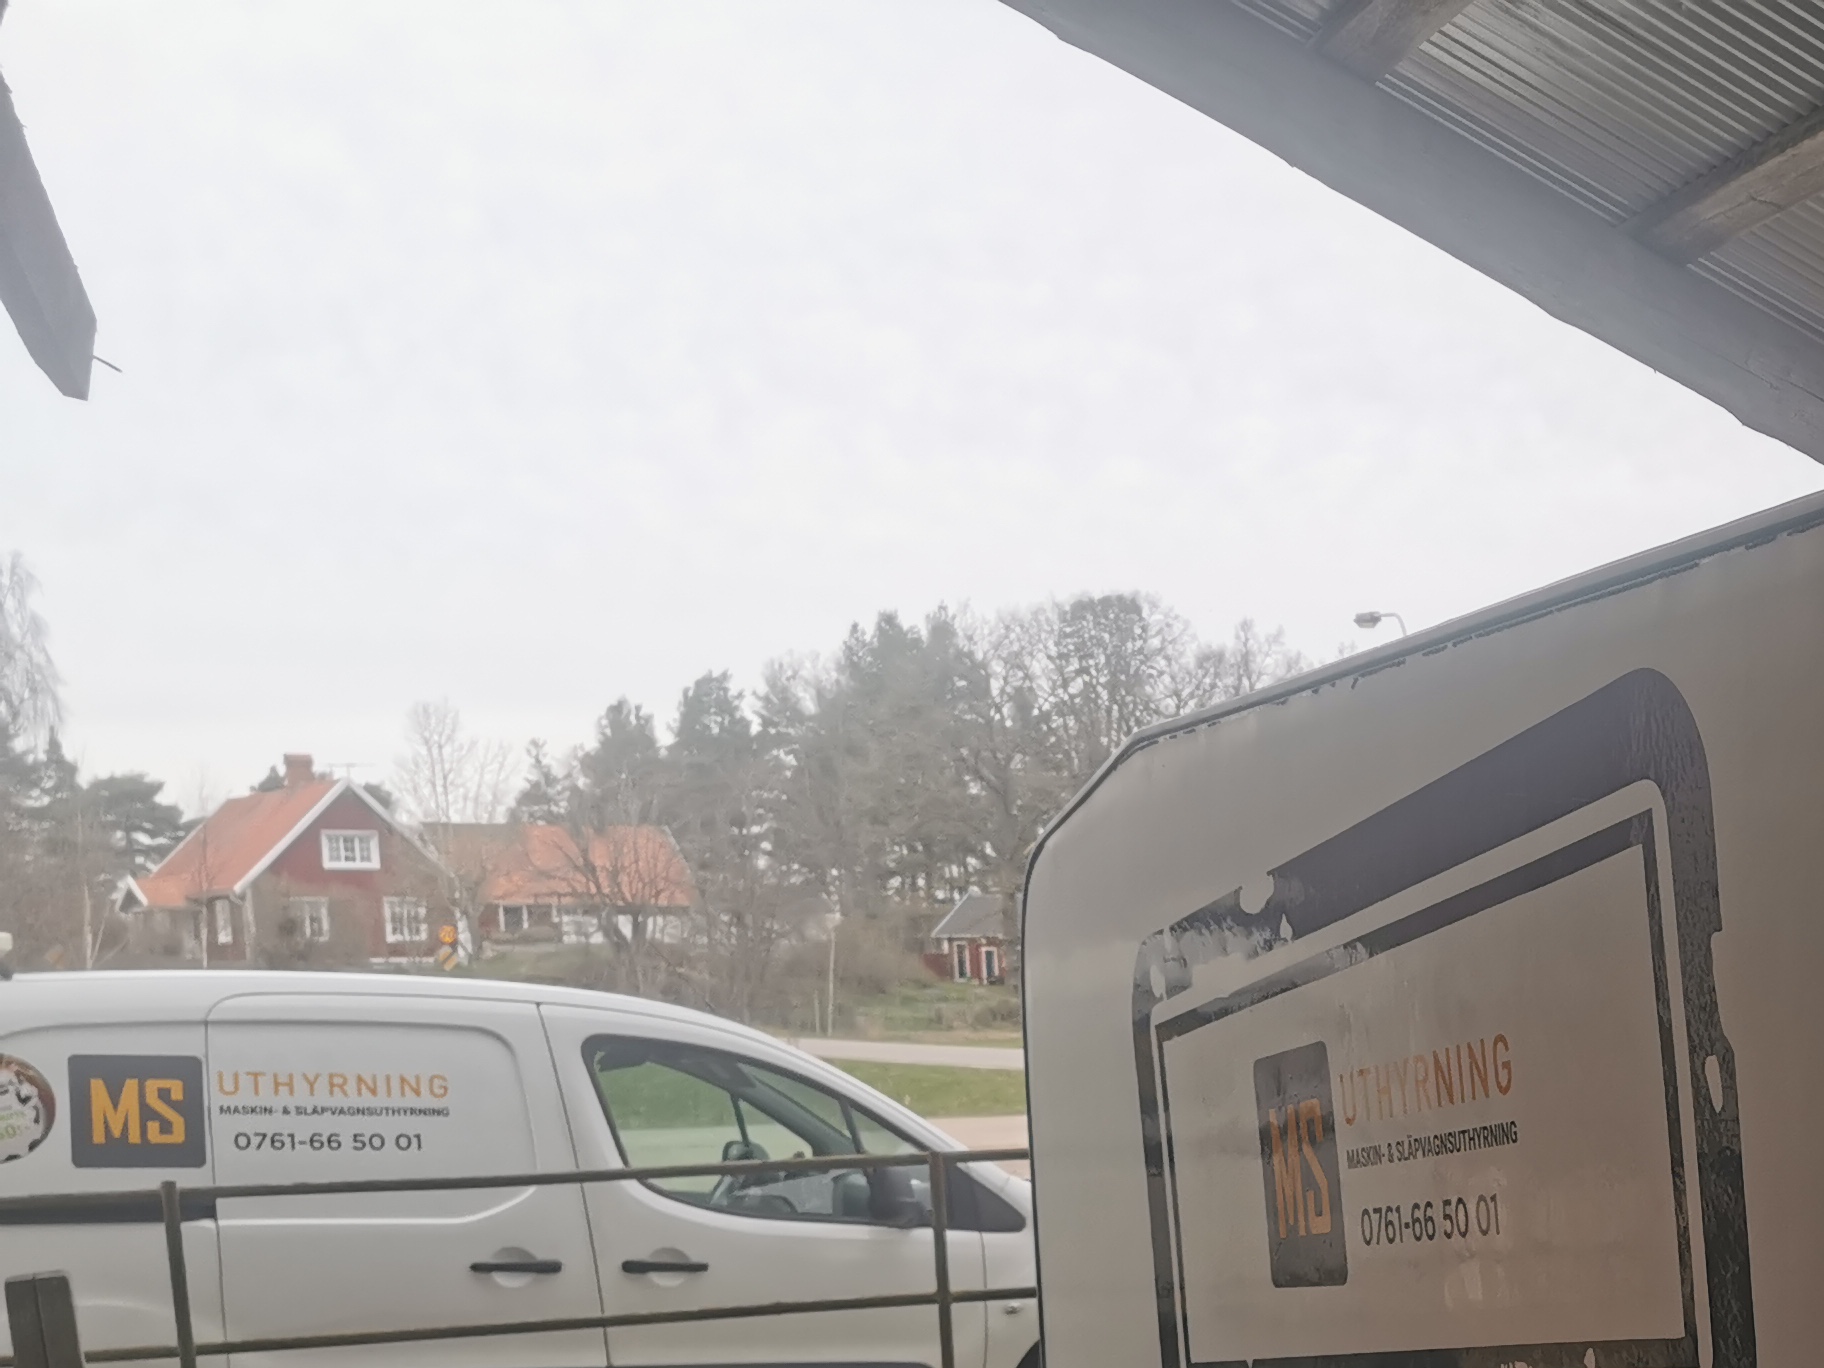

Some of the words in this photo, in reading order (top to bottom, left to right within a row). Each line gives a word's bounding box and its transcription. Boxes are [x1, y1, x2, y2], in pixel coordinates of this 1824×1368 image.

[216, 1070, 450, 1099] UTHYRNING
[1339, 1033, 1513, 1127] UTHYRNING
[89, 1077, 186, 1145] MS
[234, 1132, 343, 1151] 0761-66
[352, 1133, 385, 1151] 50
[395, 1133, 423, 1151] 01
[1269, 1097, 1332, 1240] MS
[1346, 1144, 1386, 1170] MASKIN-
[1387, 1142, 1395, 1164] &
[1395, 1120, 1519, 1163] SLÄPVAGNSUTHYRNING
[1361, 1200, 1436, 1247] 0761-66
[1443, 1197, 1469, 1240] 50
[1475, 1193, 1502, 1237] 01
